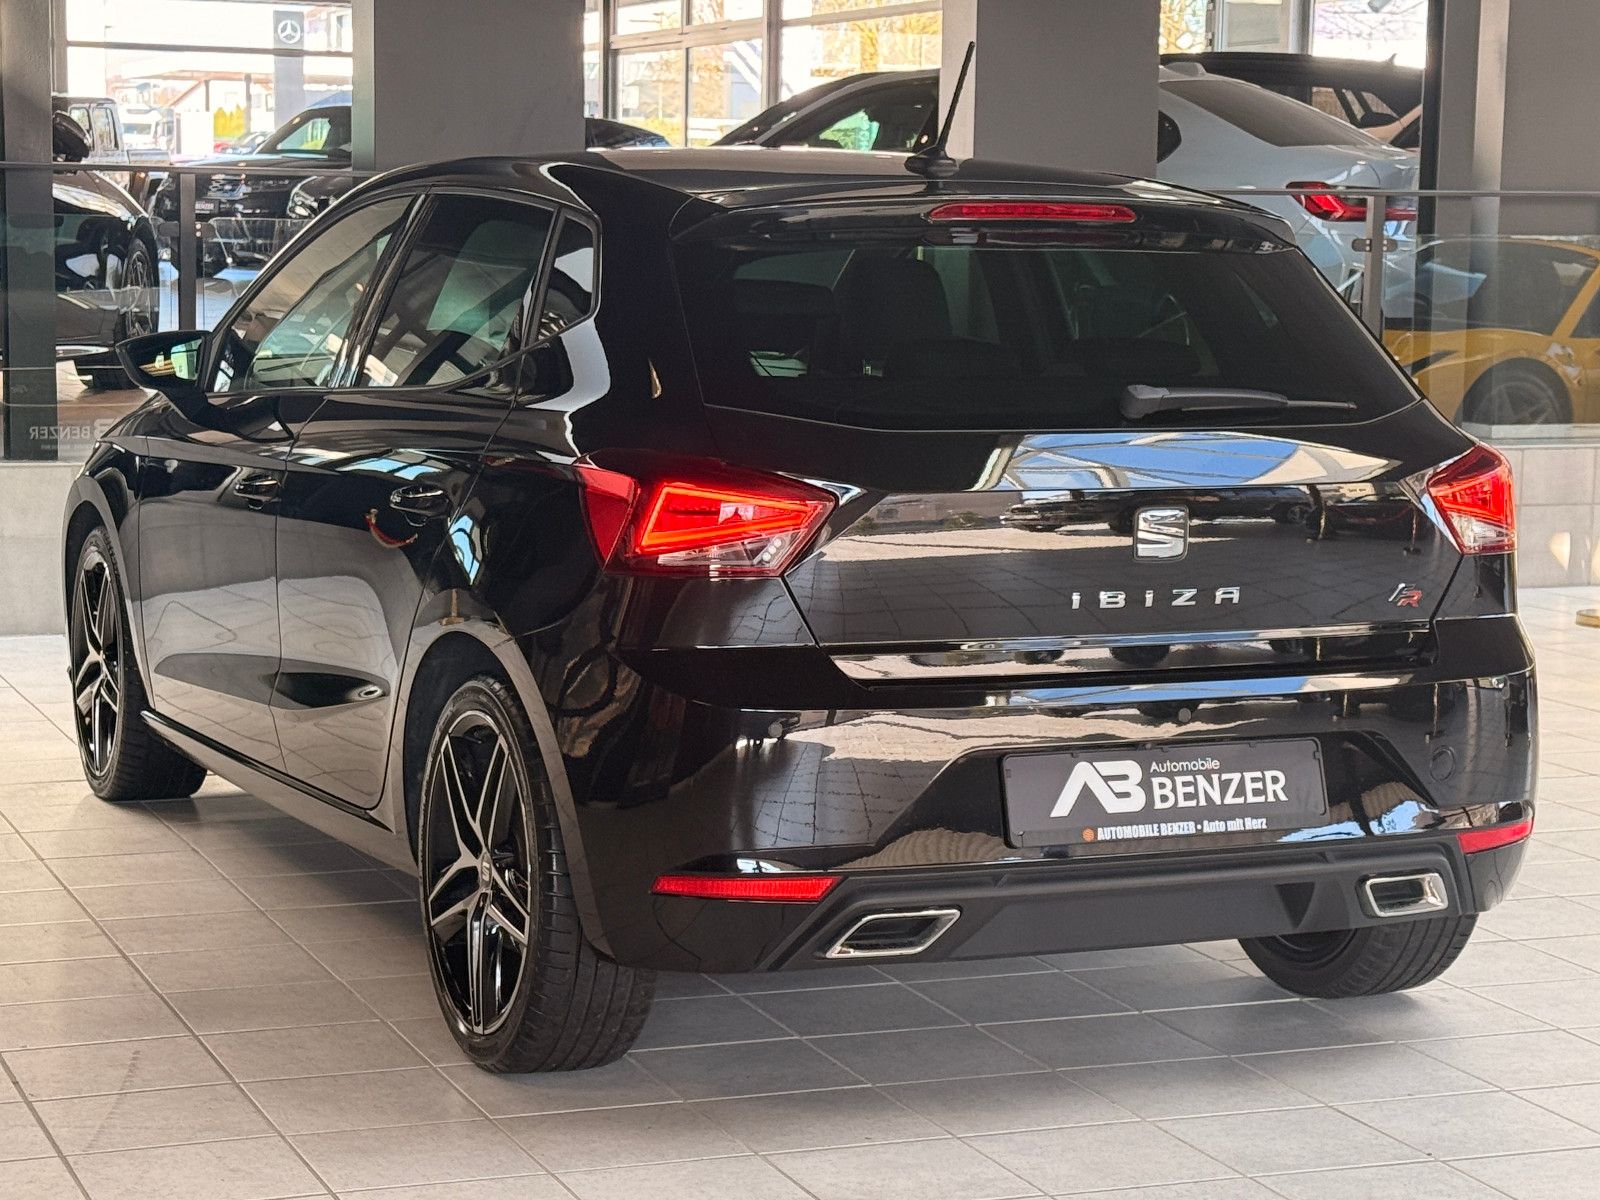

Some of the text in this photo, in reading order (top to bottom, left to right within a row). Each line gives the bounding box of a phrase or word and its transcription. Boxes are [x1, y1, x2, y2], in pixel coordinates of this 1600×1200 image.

[1149, 757, 1220, 774] Automobile
[1049, 760, 1146, 818] AB
[1152, 770, 1289, 810] BENZER
[1097, 817, 1268, 841] AUTOMOBILE BENZER Auto mit Herz
